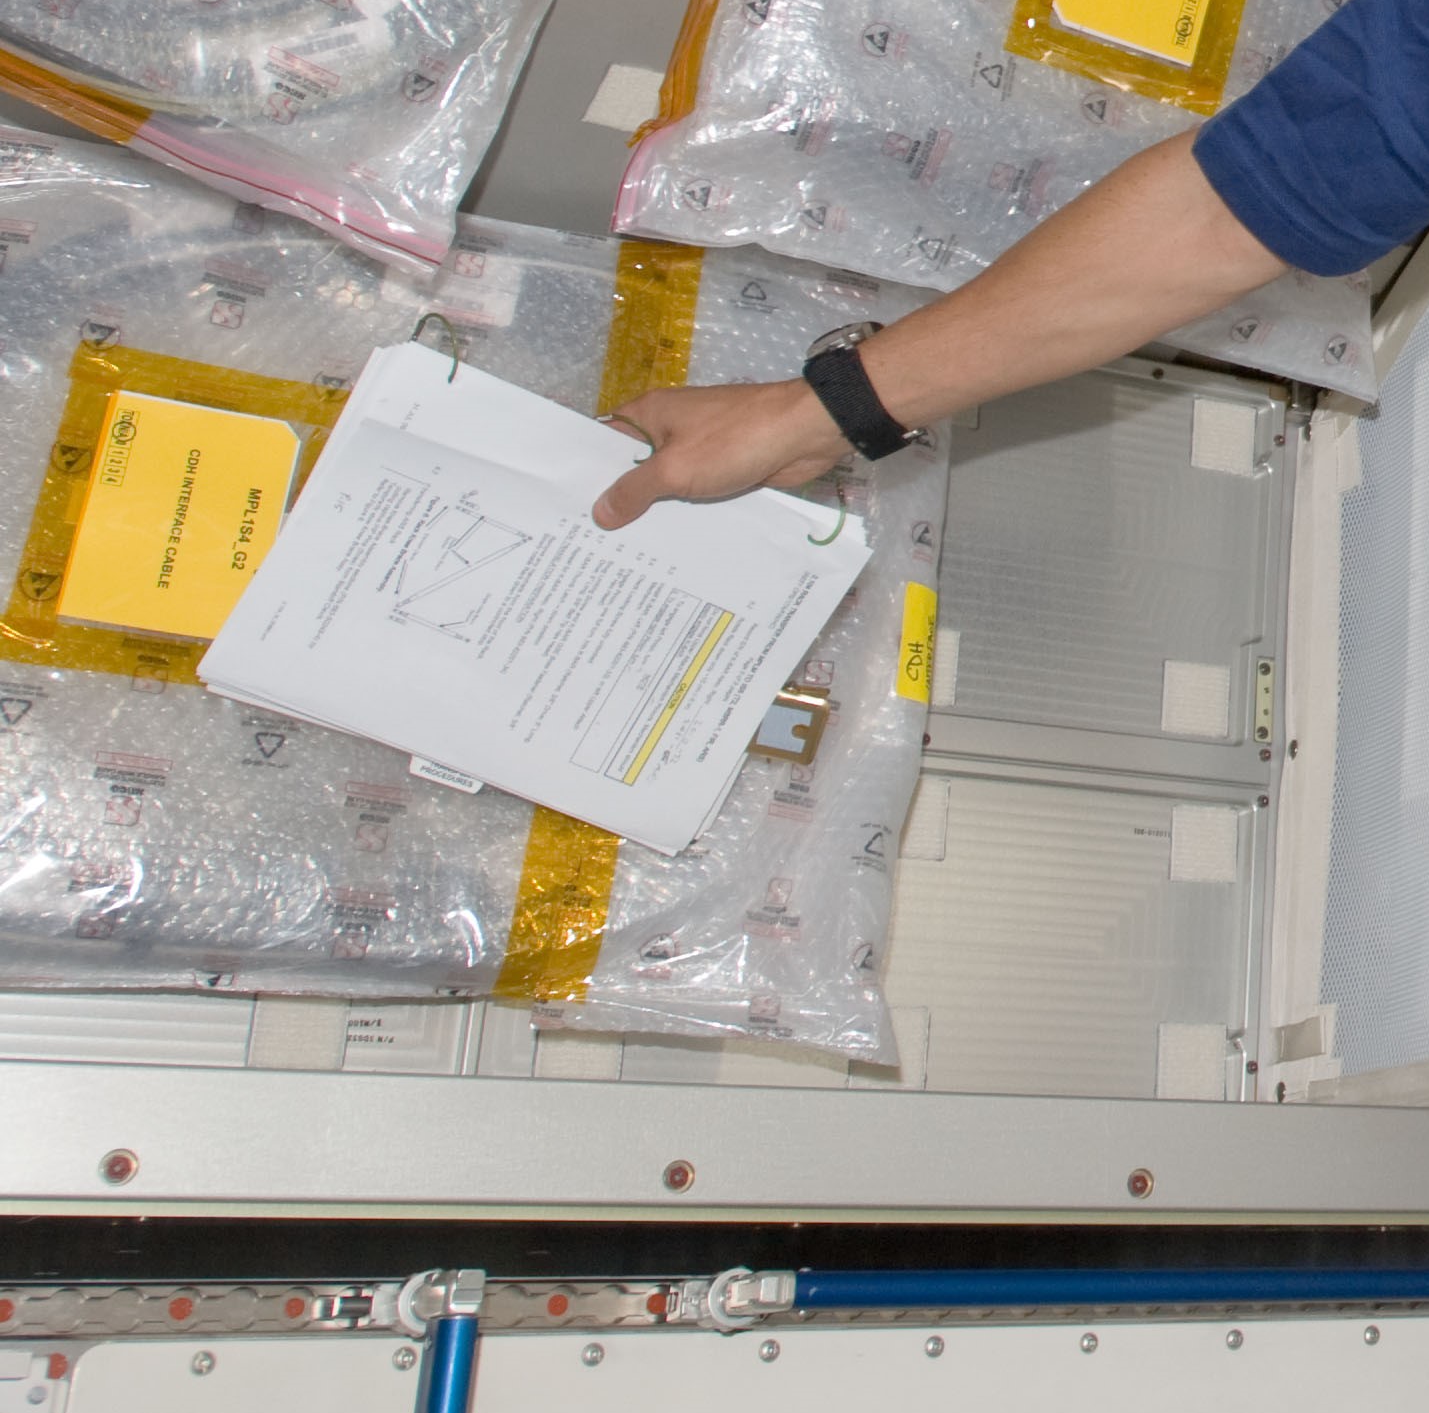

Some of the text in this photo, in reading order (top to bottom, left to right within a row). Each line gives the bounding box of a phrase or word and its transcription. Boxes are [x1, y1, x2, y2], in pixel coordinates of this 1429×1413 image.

[157, 448, 201, 588] CDH INTERFACE CABLE
[231, 487, 262, 570] MPL1S4_G2
[905, 641, 924, 681] CDH
